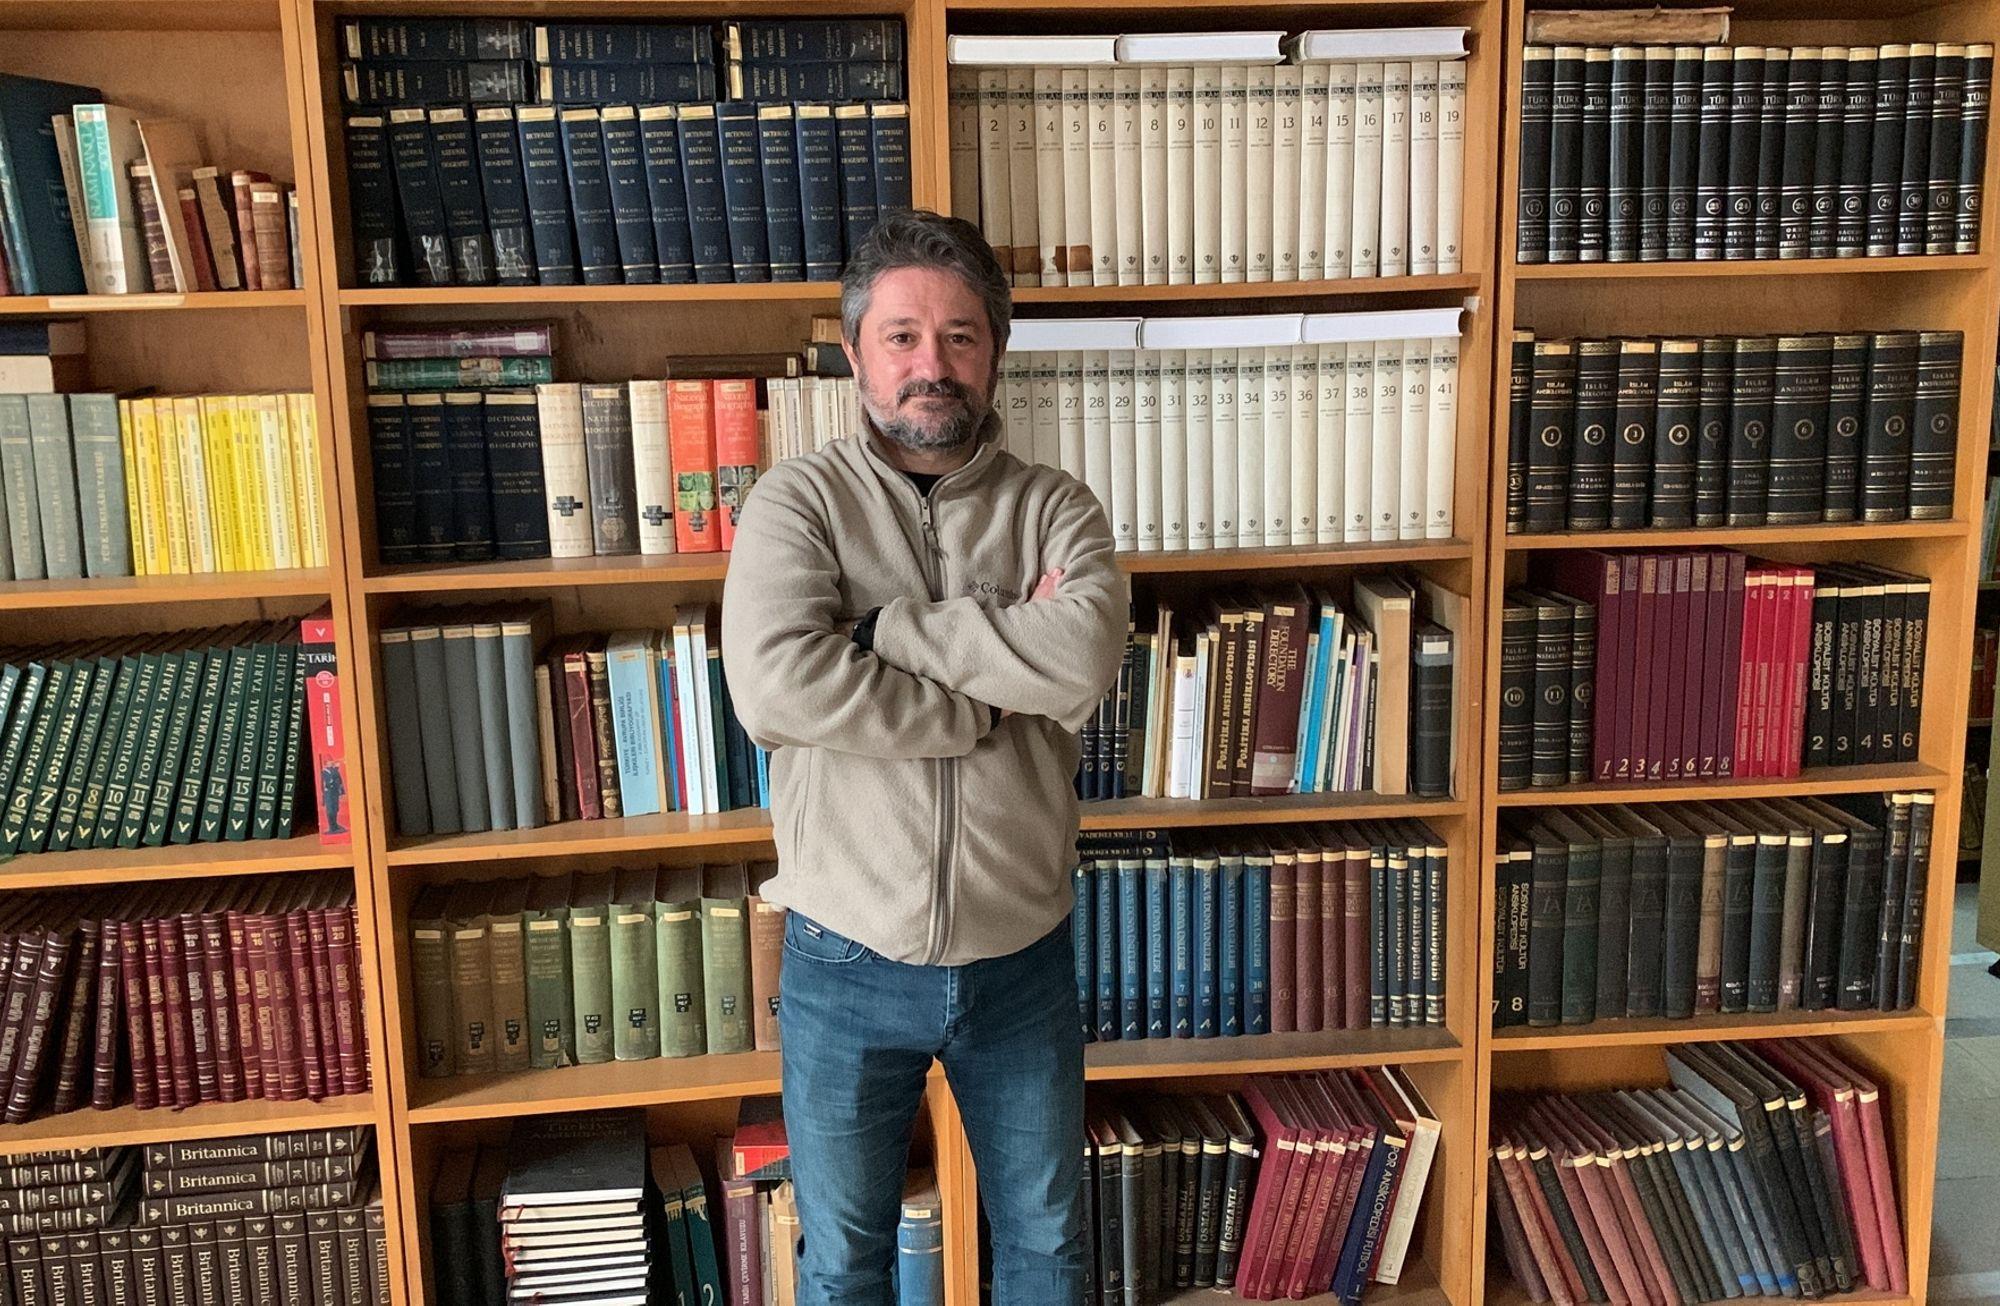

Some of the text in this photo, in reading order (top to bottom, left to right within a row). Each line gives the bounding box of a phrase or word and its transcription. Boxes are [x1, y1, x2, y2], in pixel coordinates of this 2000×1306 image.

[1229, 117, 1240, 129] 11
[1256, 117, 1268, 129] 12
[1282, 117, 1295, 129] 13
[1311, 115, 1322, 128] 14
[1336, 114, 1349, 127] 15
[1364, 113, 1377, 126] 16
[1391, 112, 1404, 124] 17
[1419, 111, 1432, 123] 18
[1447, 110, 1460, 123] 19
[989, 119, 999, 132] 2
[1018, 119, 1026, 132] 3
[1046, 120, 1055, 133] 4
[1072, 120, 1081, 133] 5
[1098, 120, 1107, 132] 6
[1124, 120, 1133, 132] 7
[1150, 119, 1159, 131] 8
[1177, 118, 1186, 131] 9
[1202, 118, 1215, 131] 10
[1324, 388, 1340, 400] 37
[1352, 387, 1368, 399] 38
[1381, 385, 1397, 398] 39
[1408, 383, 1425, 395] 40
[1437, 382, 1453, 394] 41
[1037, 396, 1053, 408] 26
[1064, 396, 1079, 408] 27
[1089, 396, 1105, 408] 28
[1114, 396, 1130, 408] 29
[1140, 395, 1156, 408] 30
[1167, 394, 1182, 406] 31
[1192, 394, 1208, 406] 32
[1217, 392, 1233, 405] 33
[1244, 392, 1260, 404] 34
[1271, 390, 1287, 402] 35
[1297, 390, 1313, 401] 36
[1011, 397, 1028, 409] 25
[1267, 630, 1279, 686] DIRECTORY
[1277, 626, 1289, 692] FOUNDATION
[1288, 648, 1297, 670] THE
[1812, 736, 1824, 750] 2
[1837, 736, 1848, 751] 3
[1861, 734, 1872, 748] 4
[1882, 734, 1893, 748] 5
[1902, 732, 1914, 747] 6
[1603, 759, 1611, 775] 1
[1618, 758, 1629, 772] 2
[1635, 757, 1646, 773] 3
[1650, 760, 1661, 775] 4
[1670, 758, 1679, 772] 5
[1685, 757, 1695, 772] 6
[1703, 757, 1713, 771] 7
[1720, 756, 1730, 771] 8
[154, 786, 170, 800] 12
[184, 783, 199, 798] 13
[210, 782, 225, 797] 14
[236, 781, 250, 795] 15
[260, 780, 275, 794] 16
[284, 783, 293, 792] 17
[14, 793, 27, 808] 6
[39, 792, 54, 806] 7
[67, 793, 77, 807] 9
[87, 789, 99, 803] 8
[107, 791, 124, 804] 10
[133, 790, 146, 803] 11
[1511, 997, 1523, 1012] 8
[181, 1144, 258, 1161] Britannica
[293, 1142, 304, 1152] 22
[1386, 1144, 1400, 1168] POR
[180, 1171, 257, 1189] Britannica
[176, 1198, 254, 1217] Britannica
[1224, 1187, 1237, 1240] OSMANLI
[1357, 1241, 1372, 1273] FUTBOL
[347, 1238, 362, 1304] Britannica
